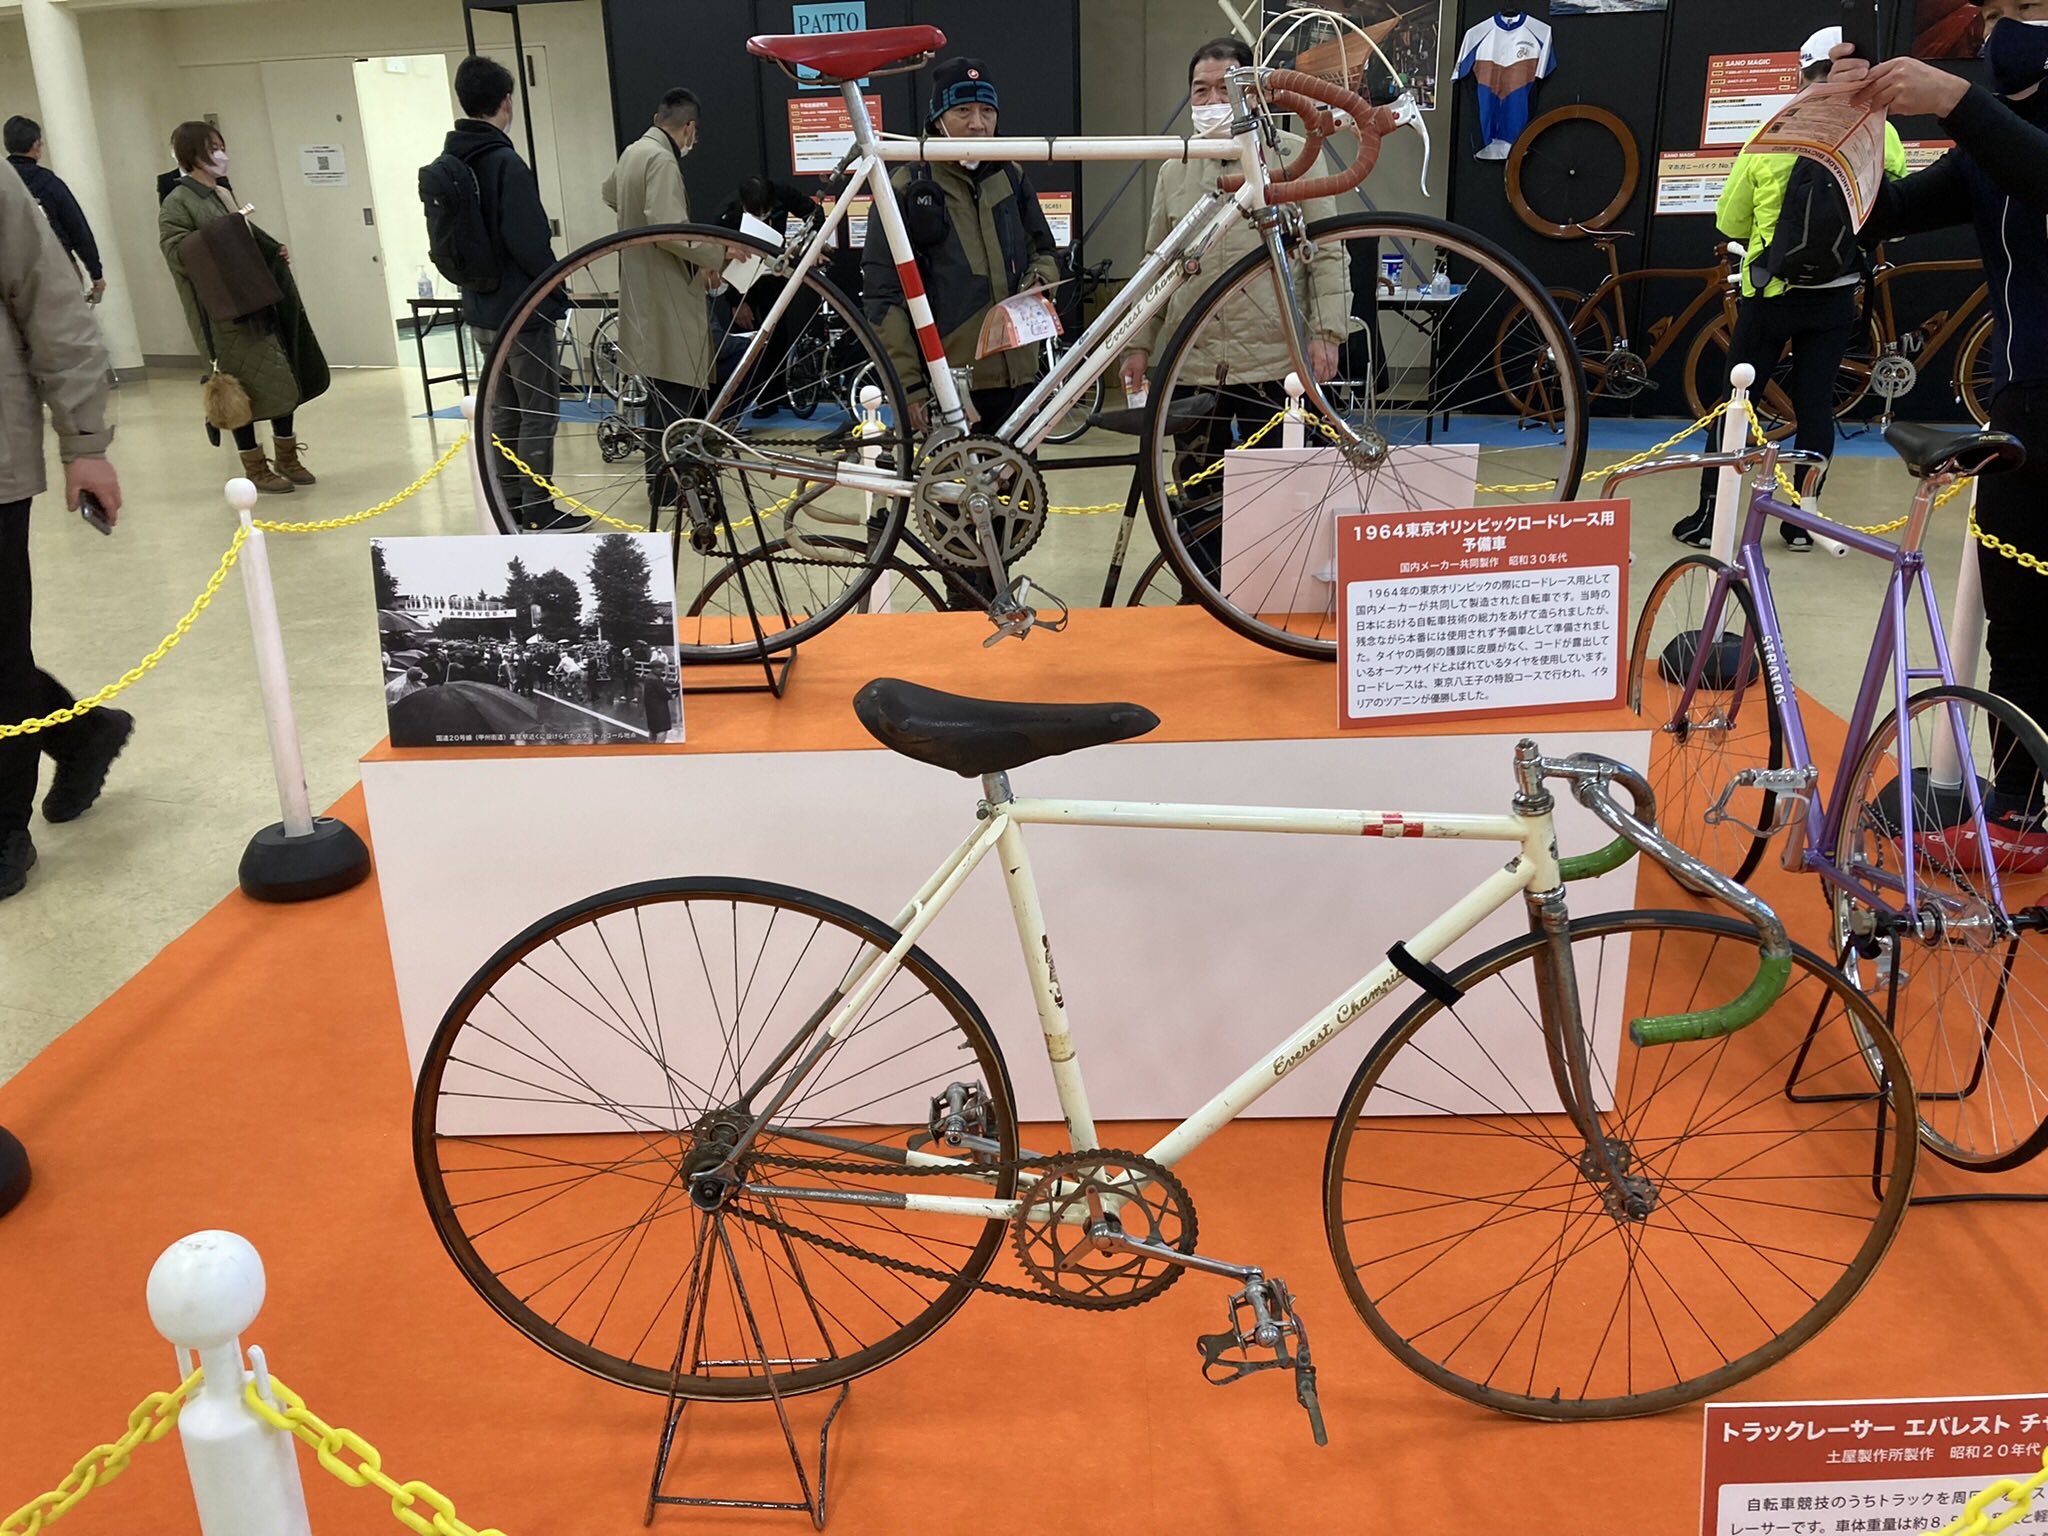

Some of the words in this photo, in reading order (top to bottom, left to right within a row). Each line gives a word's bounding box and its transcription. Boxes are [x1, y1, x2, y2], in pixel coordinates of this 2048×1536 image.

[798, 12, 859, 34] PATTO
[1353, 511, 1615, 541] 1964東京オリンピックロードレース用
[1462, 536, 1507, 553] 予備車
[1400, 558, 1499, 573] 国内メーカー共同製作
[1509, 552, 1568, 566] 昭和30年代
[1761, 635, 1787, 705] STRATOS
[1272, 1023, 1333, 1077] Everest
[1337, 969, 1404, 1024] Champio
[1723, 1420, 1896, 1443] トラックレーサー
[1904, 1414, 2010, 1436] エバレスト
[1826, 1446, 1935, 1464] 土屋製作所製作
[1950, 1442, 2041, 1459] 昭和20年代
